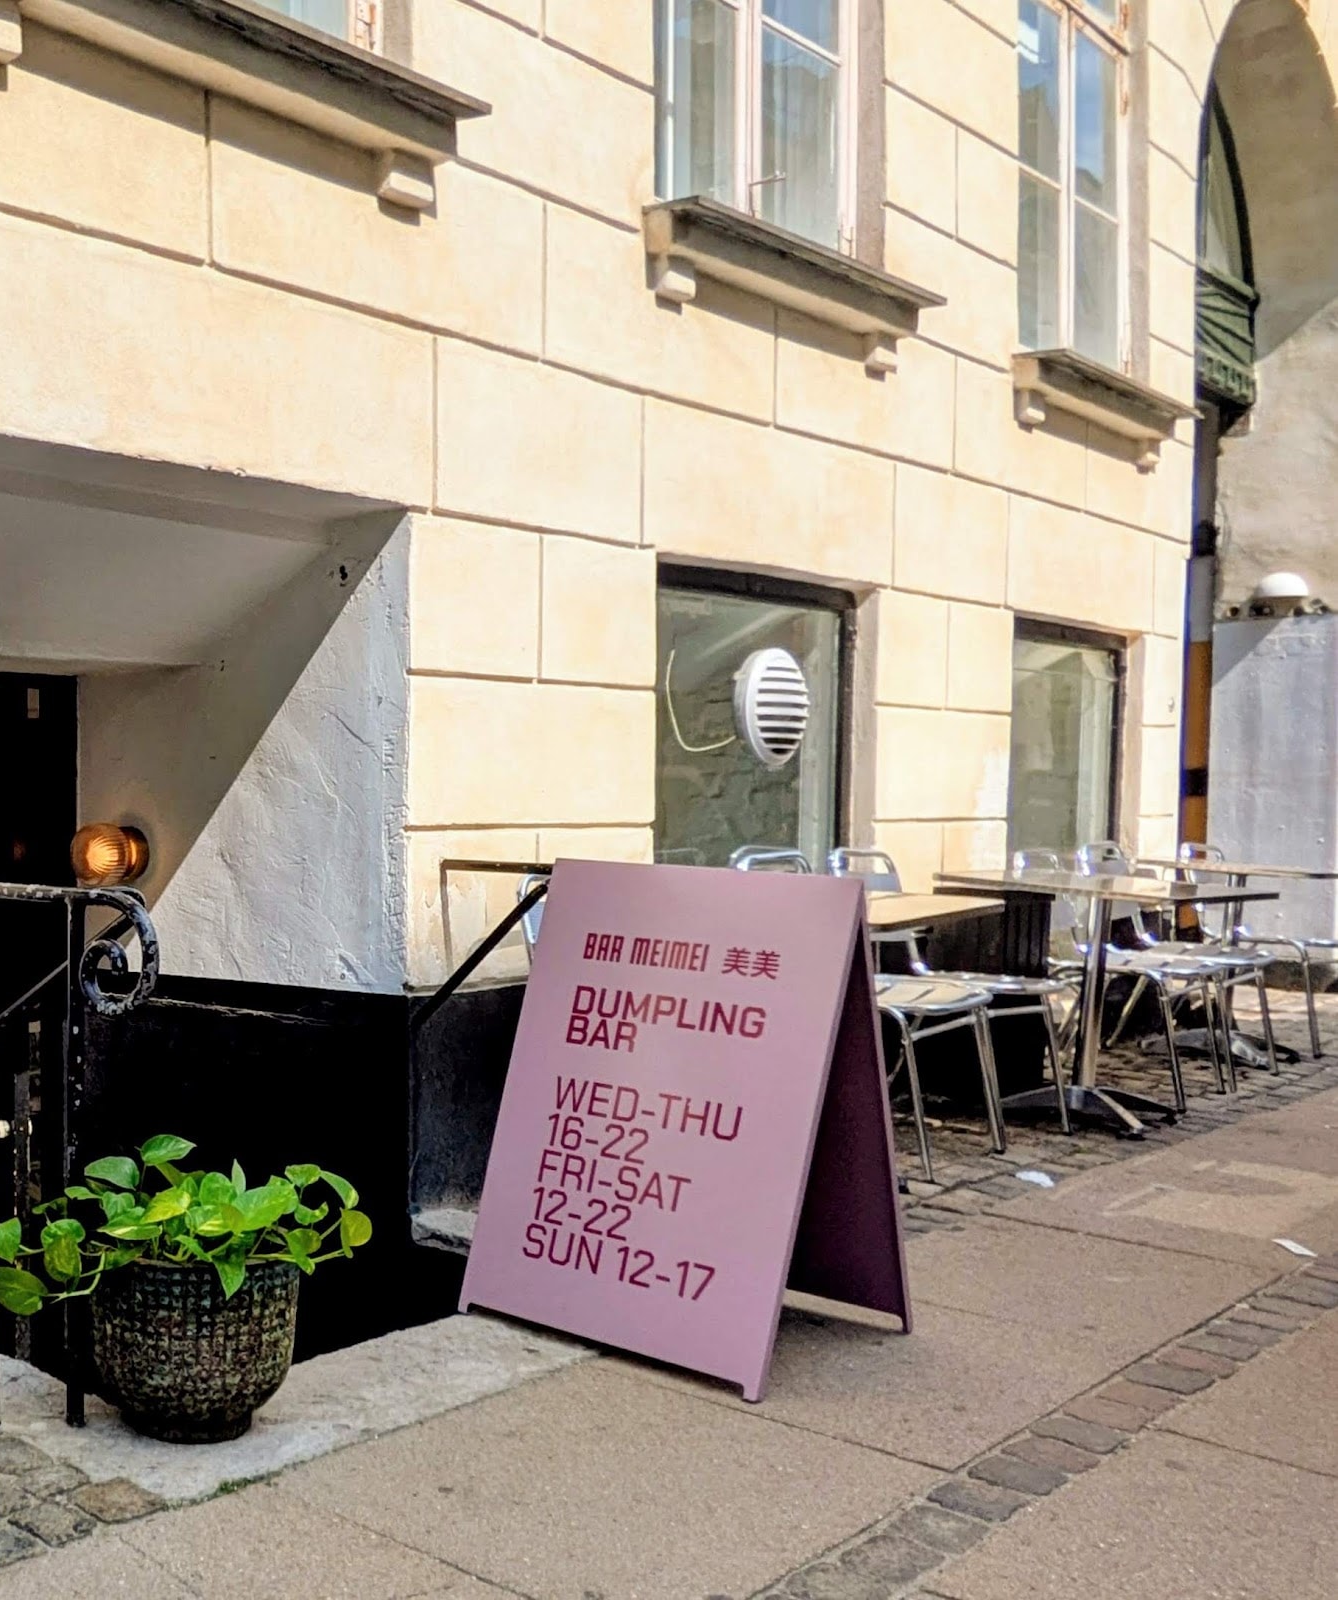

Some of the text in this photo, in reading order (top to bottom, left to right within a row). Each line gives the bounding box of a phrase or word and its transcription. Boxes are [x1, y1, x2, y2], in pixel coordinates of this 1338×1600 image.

[583, 932, 782, 981] BAR MEIMEI 美美
[565, 1014, 639, 1054] BAR
[572, 984, 768, 1040] DUMPLING
[555, 1075, 744, 1142] WED-THU
[548, 1112, 650, 1166] 16-22
[537, 1148, 693, 1213] FRI-SAT
[532, 1186, 633, 1242] 12-22
[522, 1222, 716, 1301] SUN 12-17
